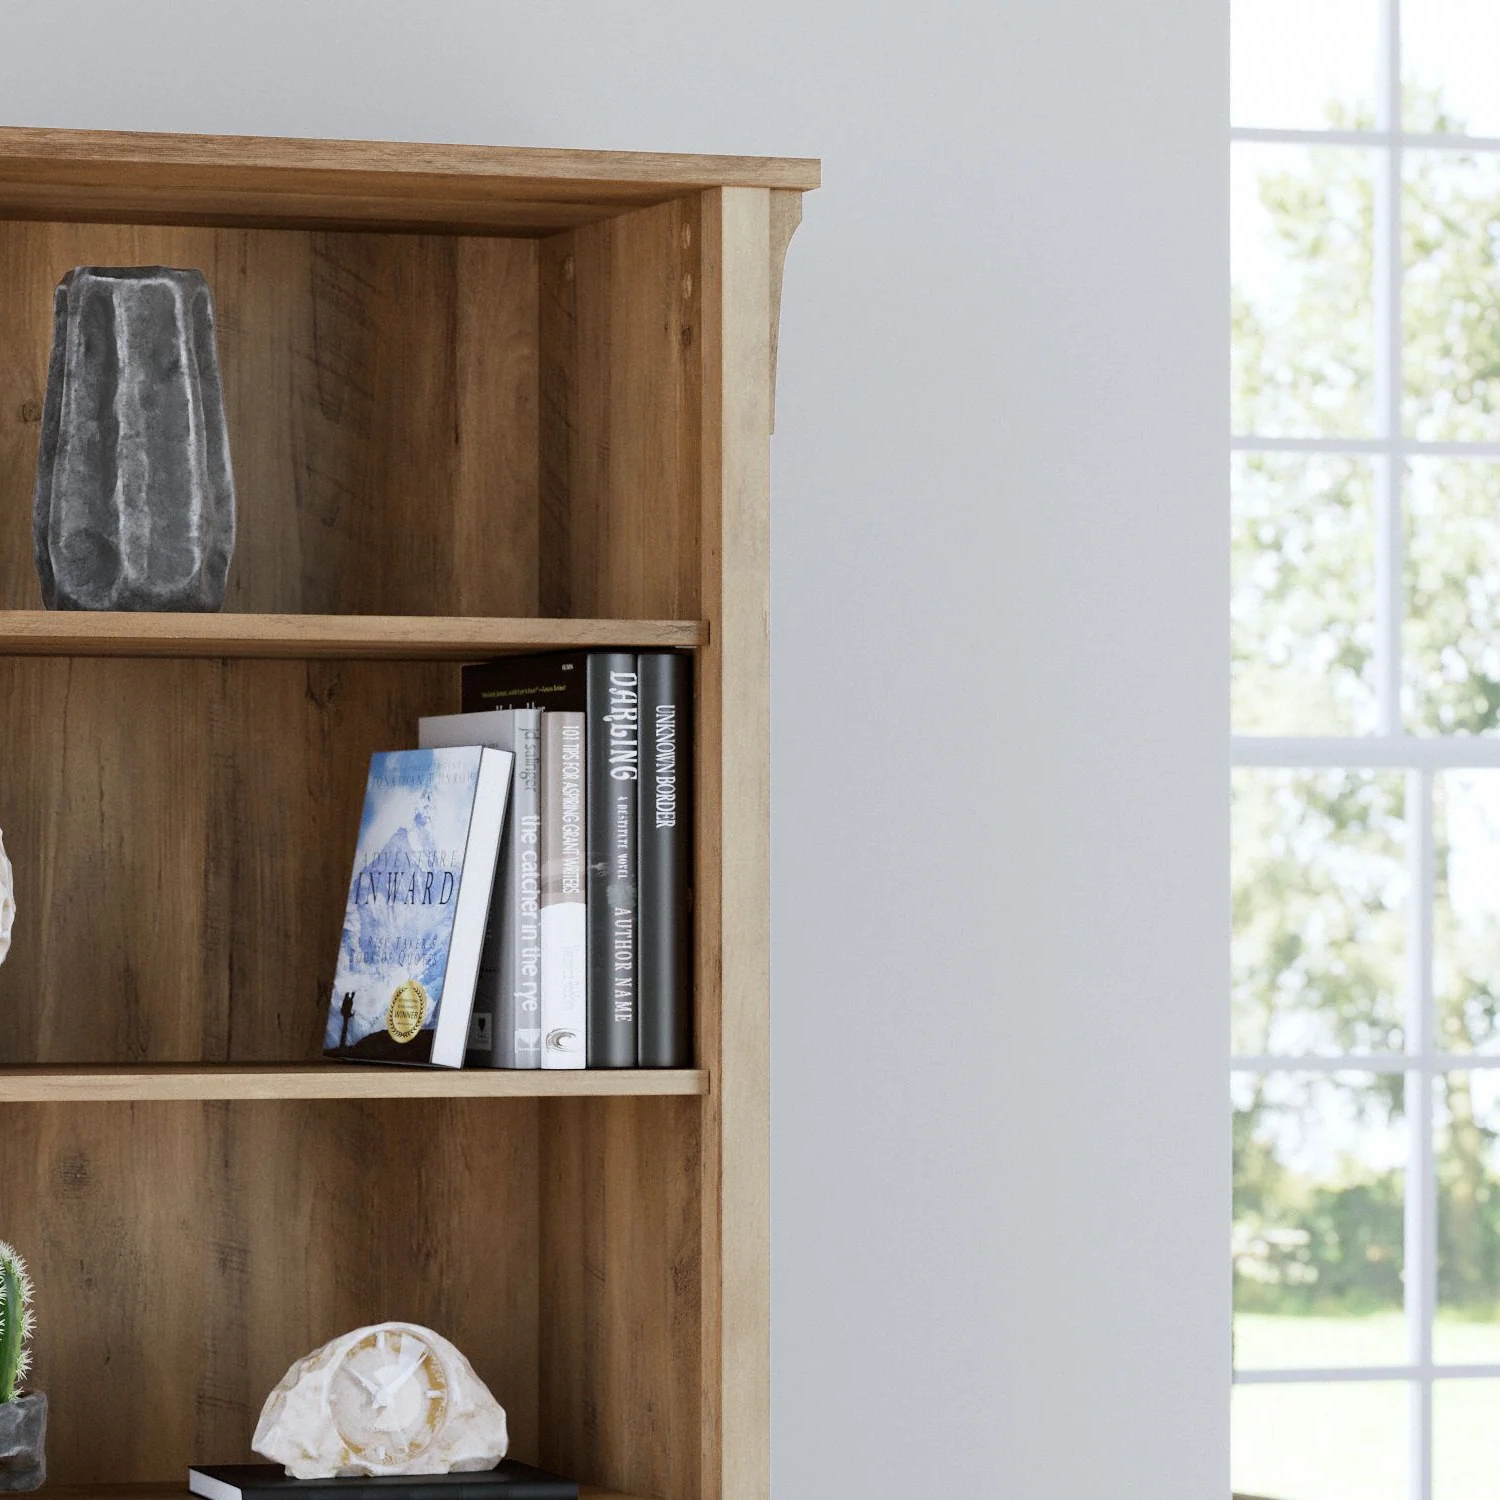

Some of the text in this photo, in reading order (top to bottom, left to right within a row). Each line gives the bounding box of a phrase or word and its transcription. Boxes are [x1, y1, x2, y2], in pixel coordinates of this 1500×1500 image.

[519, 743, 540, 793] salinger
[603, 671, 638, 781] DARLING
[655, 705, 676, 829] UNKNOWN BORDER
[362, 850, 460, 868] ADVENTURE
[562, 725, 581, 894] 101 TIPS FOR ASPIRING GRANT WRITERS
[354, 872, 455, 904] INWARD
[514, 814, 541, 1012] the catcher in the rye
[395, 1010, 419, 1019] WINNER
[614, 907, 632, 1022] AUTHOR NAME
